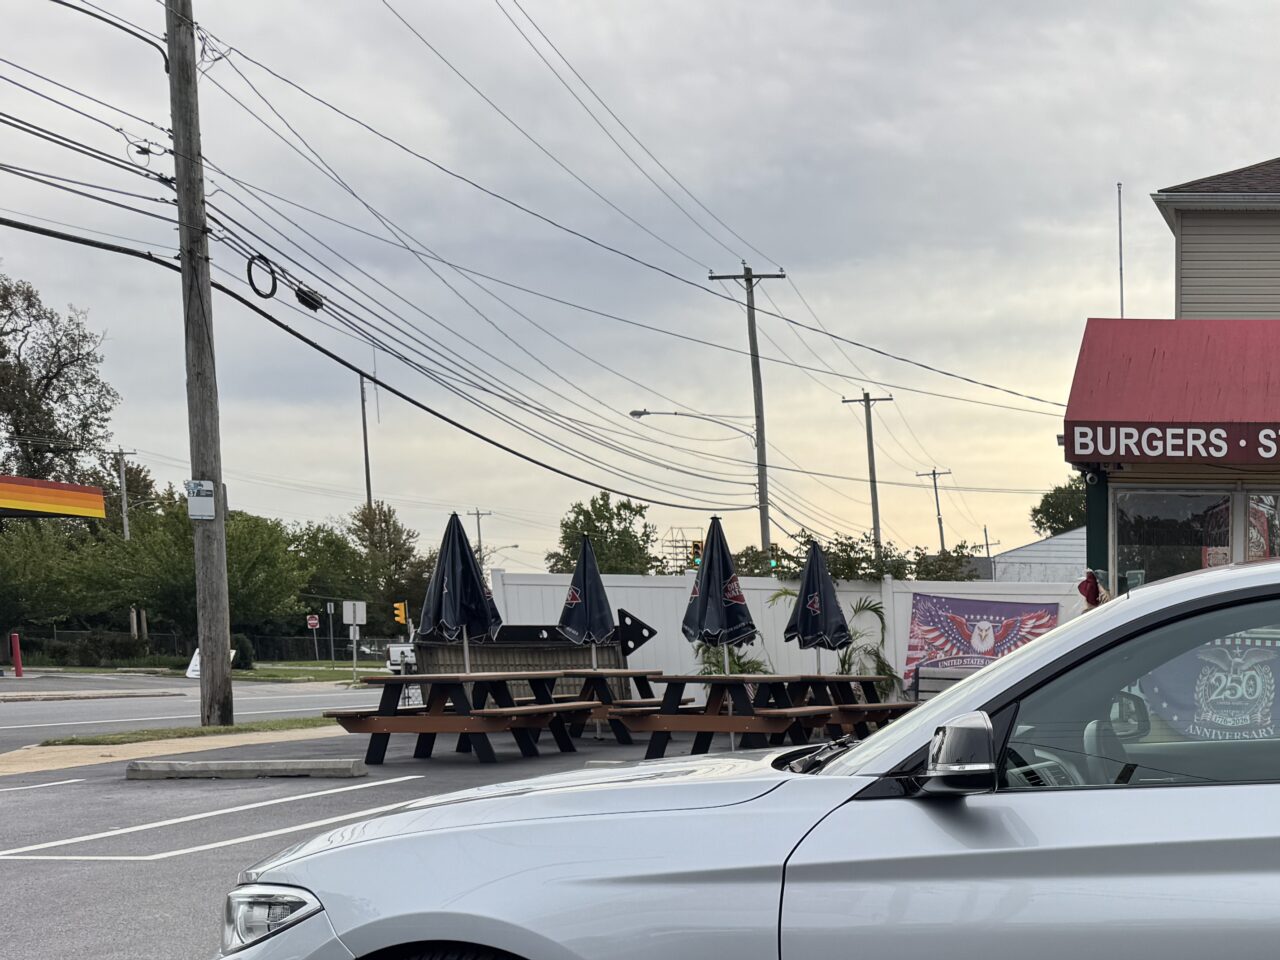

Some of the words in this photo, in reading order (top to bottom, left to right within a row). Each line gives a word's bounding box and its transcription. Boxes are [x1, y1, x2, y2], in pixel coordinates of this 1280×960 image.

[1074, 426, 1228, 458] BURGERS
[938, 659, 962, 668] UNITED
[963, 658, 985, 666] STATES
[1208, 670, 1262, 702] 250
[1185, 724, 1275, 740] ANNIVERSARY
